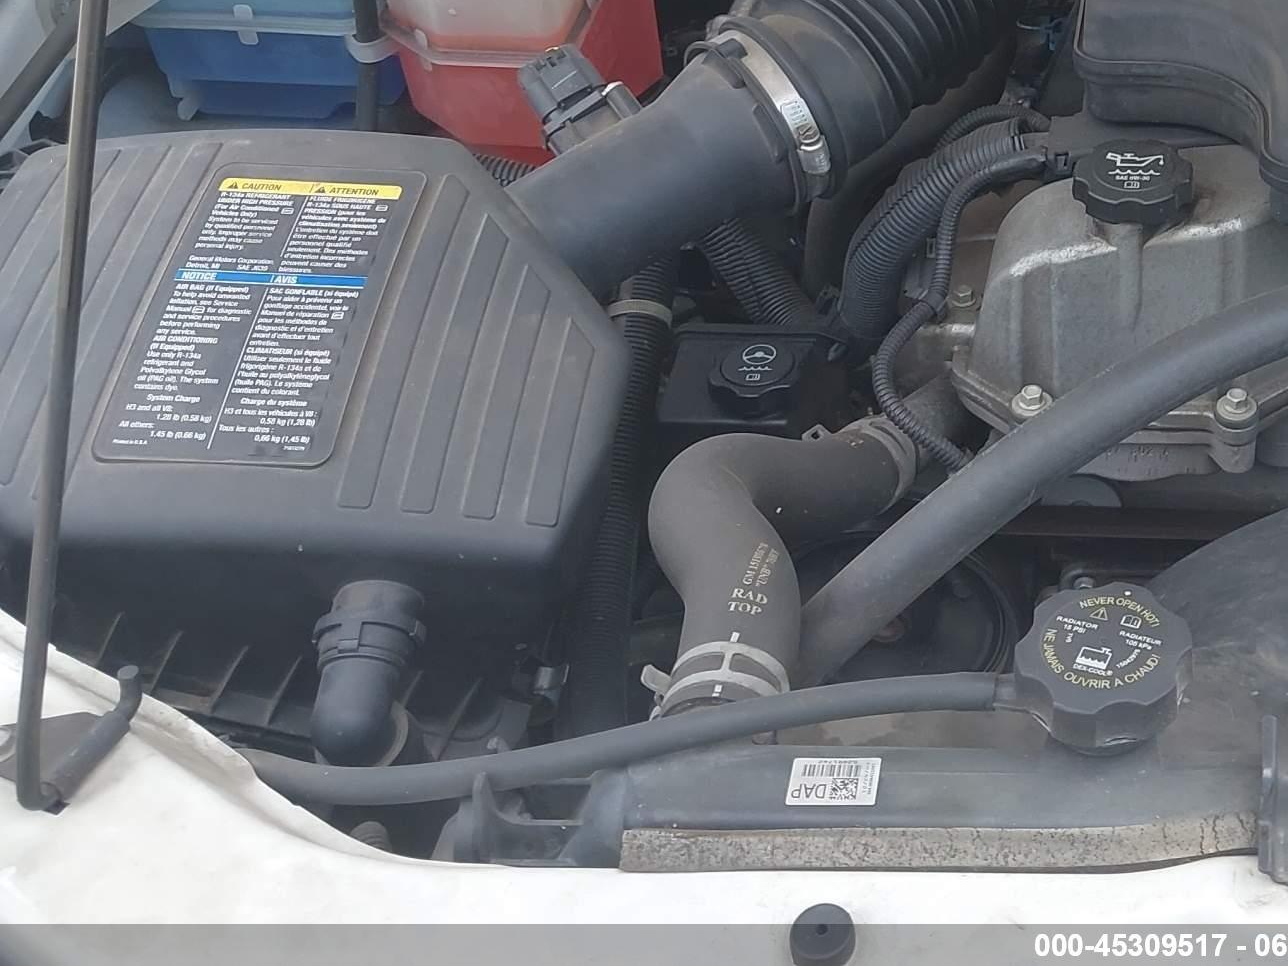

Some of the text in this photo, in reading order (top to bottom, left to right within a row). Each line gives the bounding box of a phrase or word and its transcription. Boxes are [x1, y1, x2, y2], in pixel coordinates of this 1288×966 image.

[146, 393, 201, 403] System Charge
[240, 397, 266, 405] Charge
[180, 414, 199, 422] (0.58
[287, 418, 305, 426] (1,28
[149, 430, 166, 438] 1.45
[193, 432, 207, 440] kg)
[253, 434, 271, 442] 0,66
[281, 435, 300, 443] (1,45
[743, 570, 756, 585] GM
[732, 588, 768, 604] RAD
[728, 601, 762, 615] TOP
[1080, 597, 1160, 627] NEVER OPEN HOT!
[1056, 616, 1098, 630] RADIATOR
[1072, 625, 1086, 634] PSI
[1044, 628, 1058, 642] NE
[1120, 631, 1162, 645] RADIATEUR
[1126, 639, 1152, 650] 105 kPa
[1044, 644, 1064, 674] JAMAIS
[1124, 654, 1160, 683] CHAUD!
[1064, 672, 1111, 689] OUVRIR
[791, 783, 826, 799] DAP
